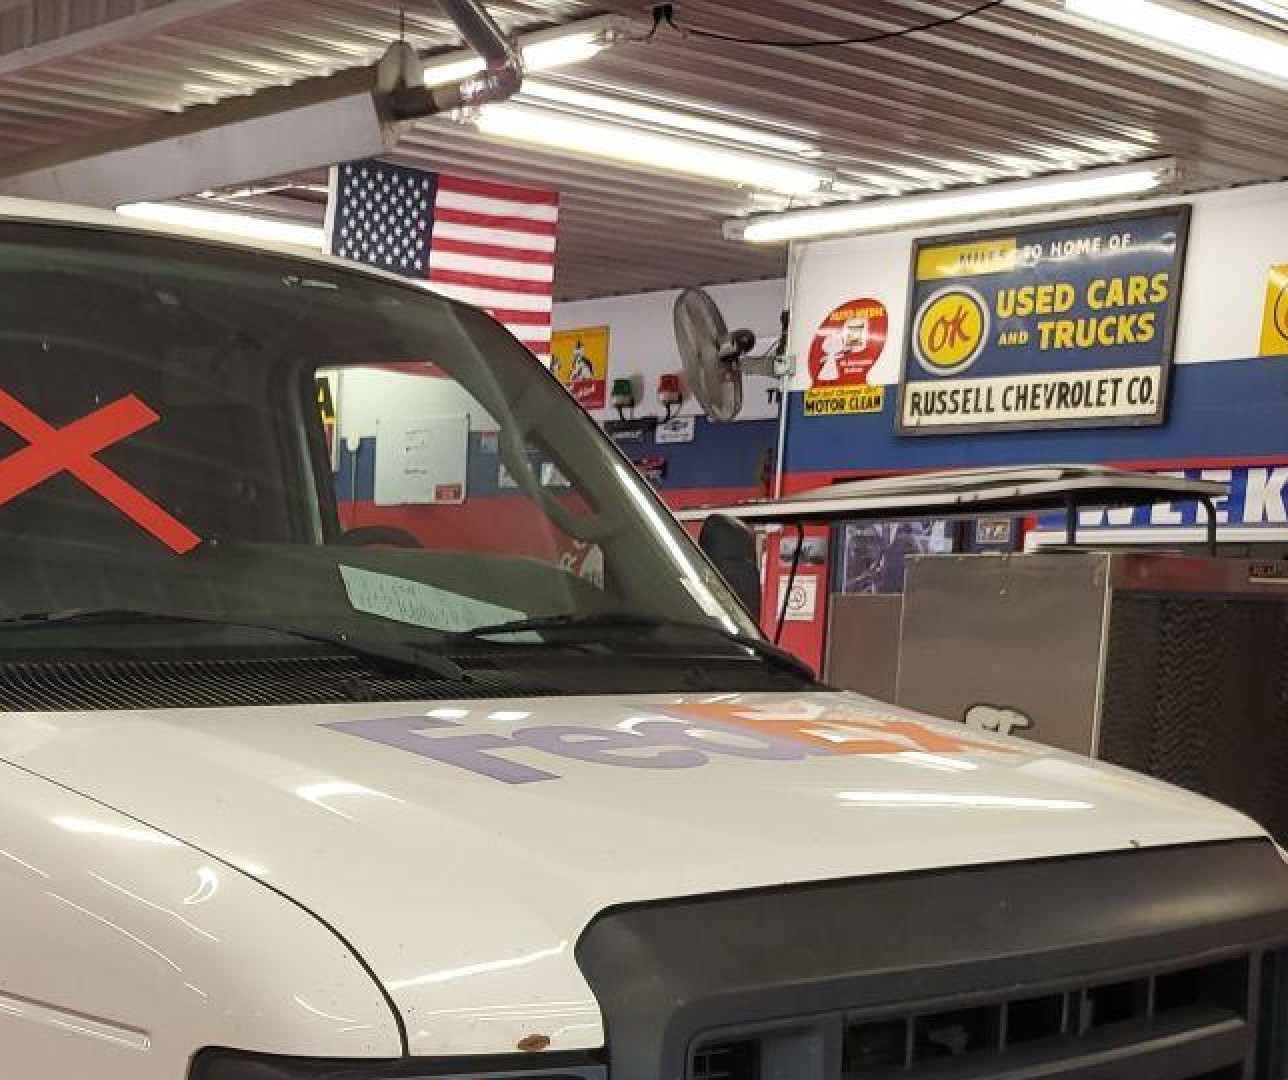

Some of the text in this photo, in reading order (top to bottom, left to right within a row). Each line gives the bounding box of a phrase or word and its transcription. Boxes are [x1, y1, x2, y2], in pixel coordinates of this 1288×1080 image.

[1051, 236, 1102, 257] HOME
[1108, 233, 1132, 250] OF
[996, 272, 1170, 319] USED CARS
[926, 304, 972, 354] OK
[997, 311, 1157, 351] AND TRUCKS
[804, 396, 846, 413] MOTOR
[909, 375, 1156, 418] RUSSELL CHEVROLET CO.
